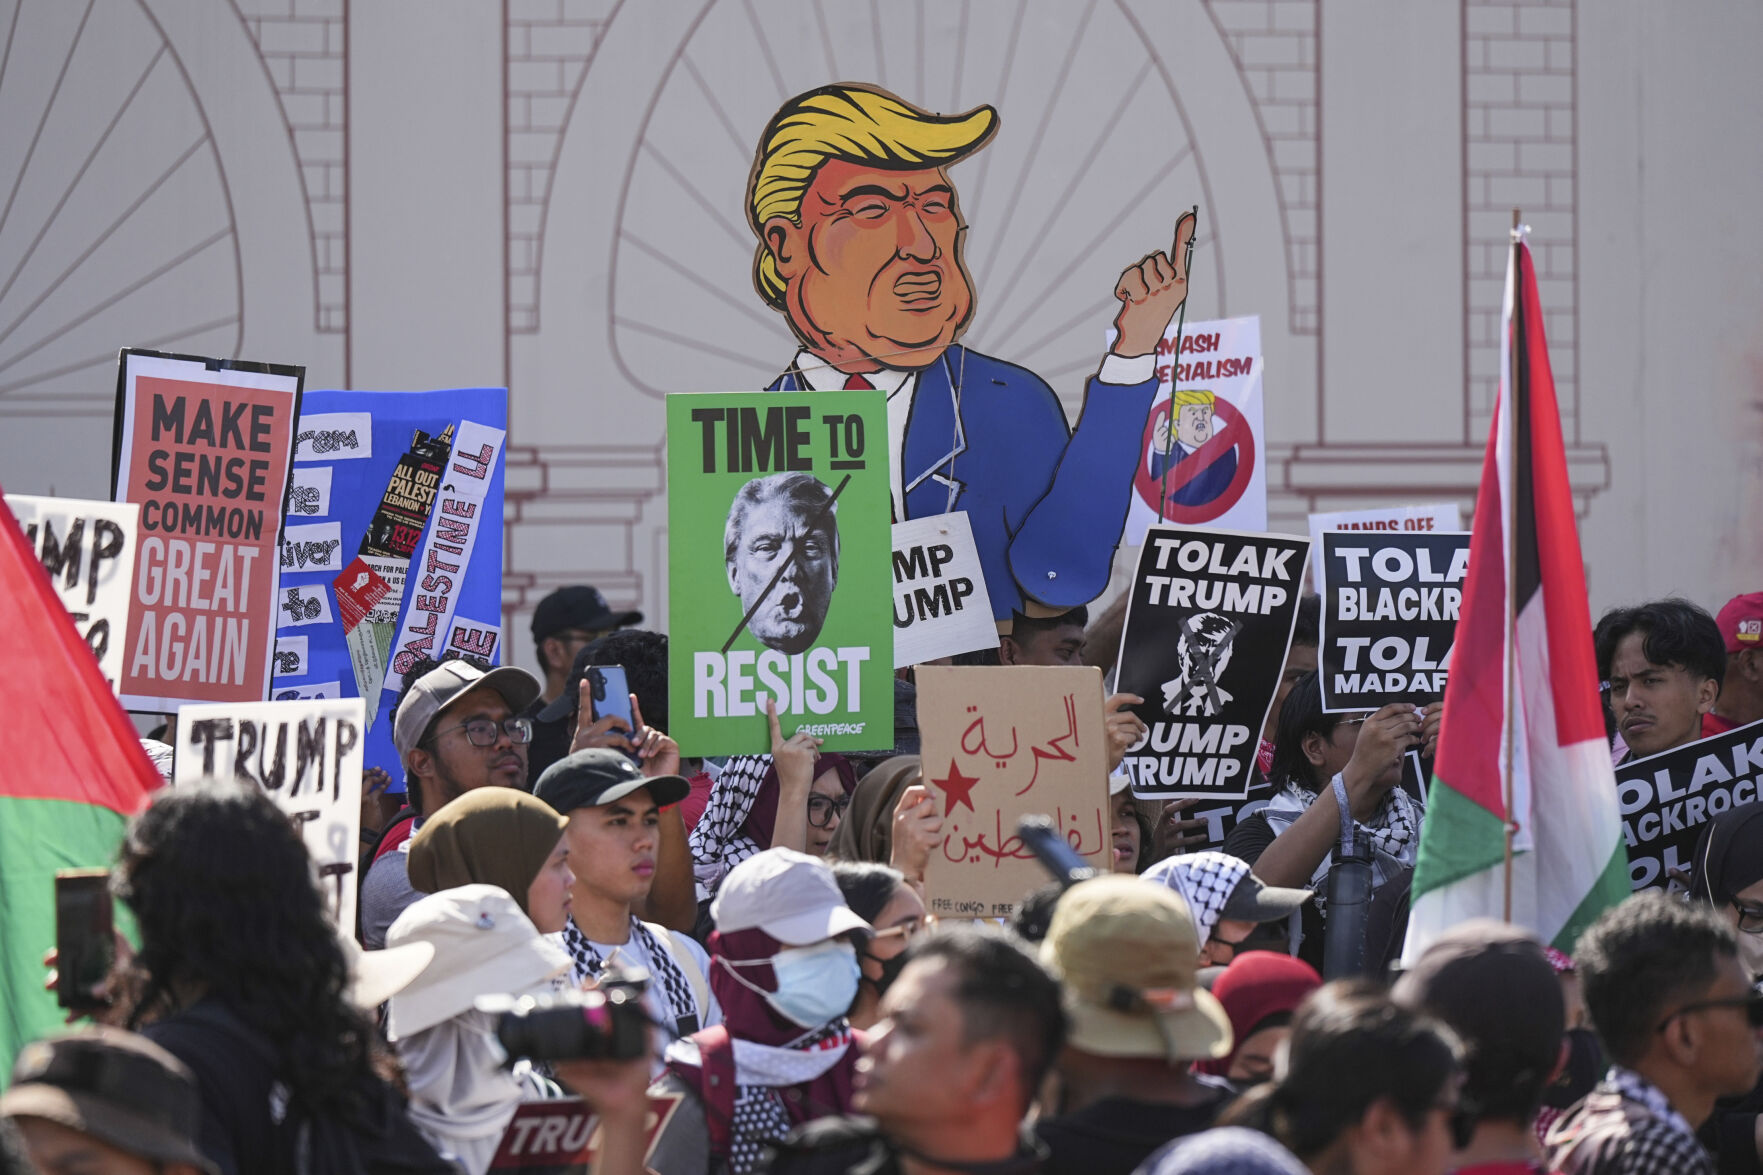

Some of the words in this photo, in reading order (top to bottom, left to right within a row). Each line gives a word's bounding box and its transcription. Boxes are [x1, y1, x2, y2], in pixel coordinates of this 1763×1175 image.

[1155, 333, 1220, 356] SMASH
[1155, 357, 1253, 383] ERIALISM
[151, 393, 274, 453] MAKE
[691, 406, 812, 473] TIME
[822, 414, 866, 460] TO
[145, 449, 269, 501] SENSE
[386, 476, 437, 505] PALEST
[393, 463, 413, 480] ALL
[415, 469, 439, 488] OUT
[383, 492, 420, 512] LEBANON
[143, 499, 264, 541] COMMON
[391, 524, 423, 547] 13.12
[138, 536, 259, 613] GREAT
[383, 565, 394, 573] FOR
[1154, 538, 1296, 580] TOLAK
[1335, 547, 1470, 583] TOLA
[282, 588, 322, 622] to
[1146, 575, 1287, 615] TRUMP
[1338, 587, 1463, 621] BLACKR
[130, 610, 249, 685] AGAIN
[694, 647, 870, 718] RESIST
[795, 722, 866, 736] GREENPEACE
[961, 693, 1079, 796] الحرية
[1124, 722, 1250, 754] DUMP
[190, 717, 358, 802] TRUMP
[1124, 756, 1241, 786] TRUMP
[932, 898, 952, 911] FREE
[955, 901, 984, 916] CONGO
[992, 903, 1014, 915] FREE
